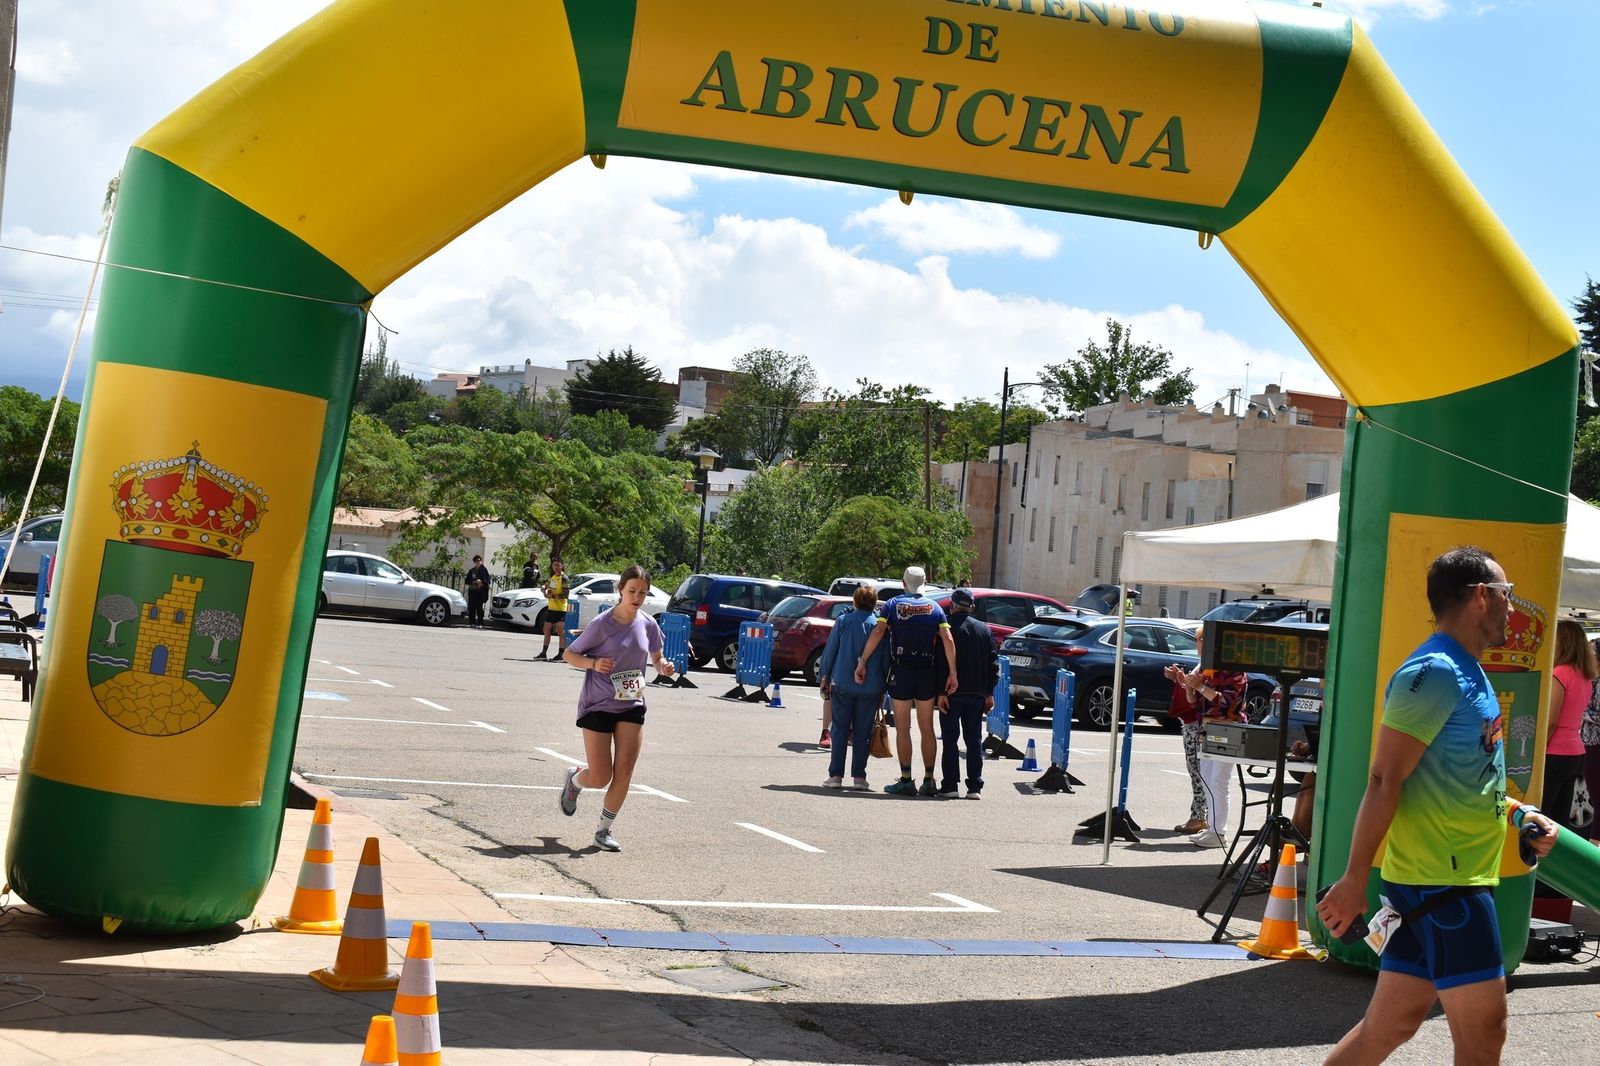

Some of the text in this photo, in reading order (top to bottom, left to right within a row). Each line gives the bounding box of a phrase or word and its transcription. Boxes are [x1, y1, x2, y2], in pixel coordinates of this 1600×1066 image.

[922, 16, 1000, 63] DE
[680, 50, 1191, 174] ABRUCENA
[622, 680, 640, 689] 561
[1296, 699, 1313, 709] 9268
